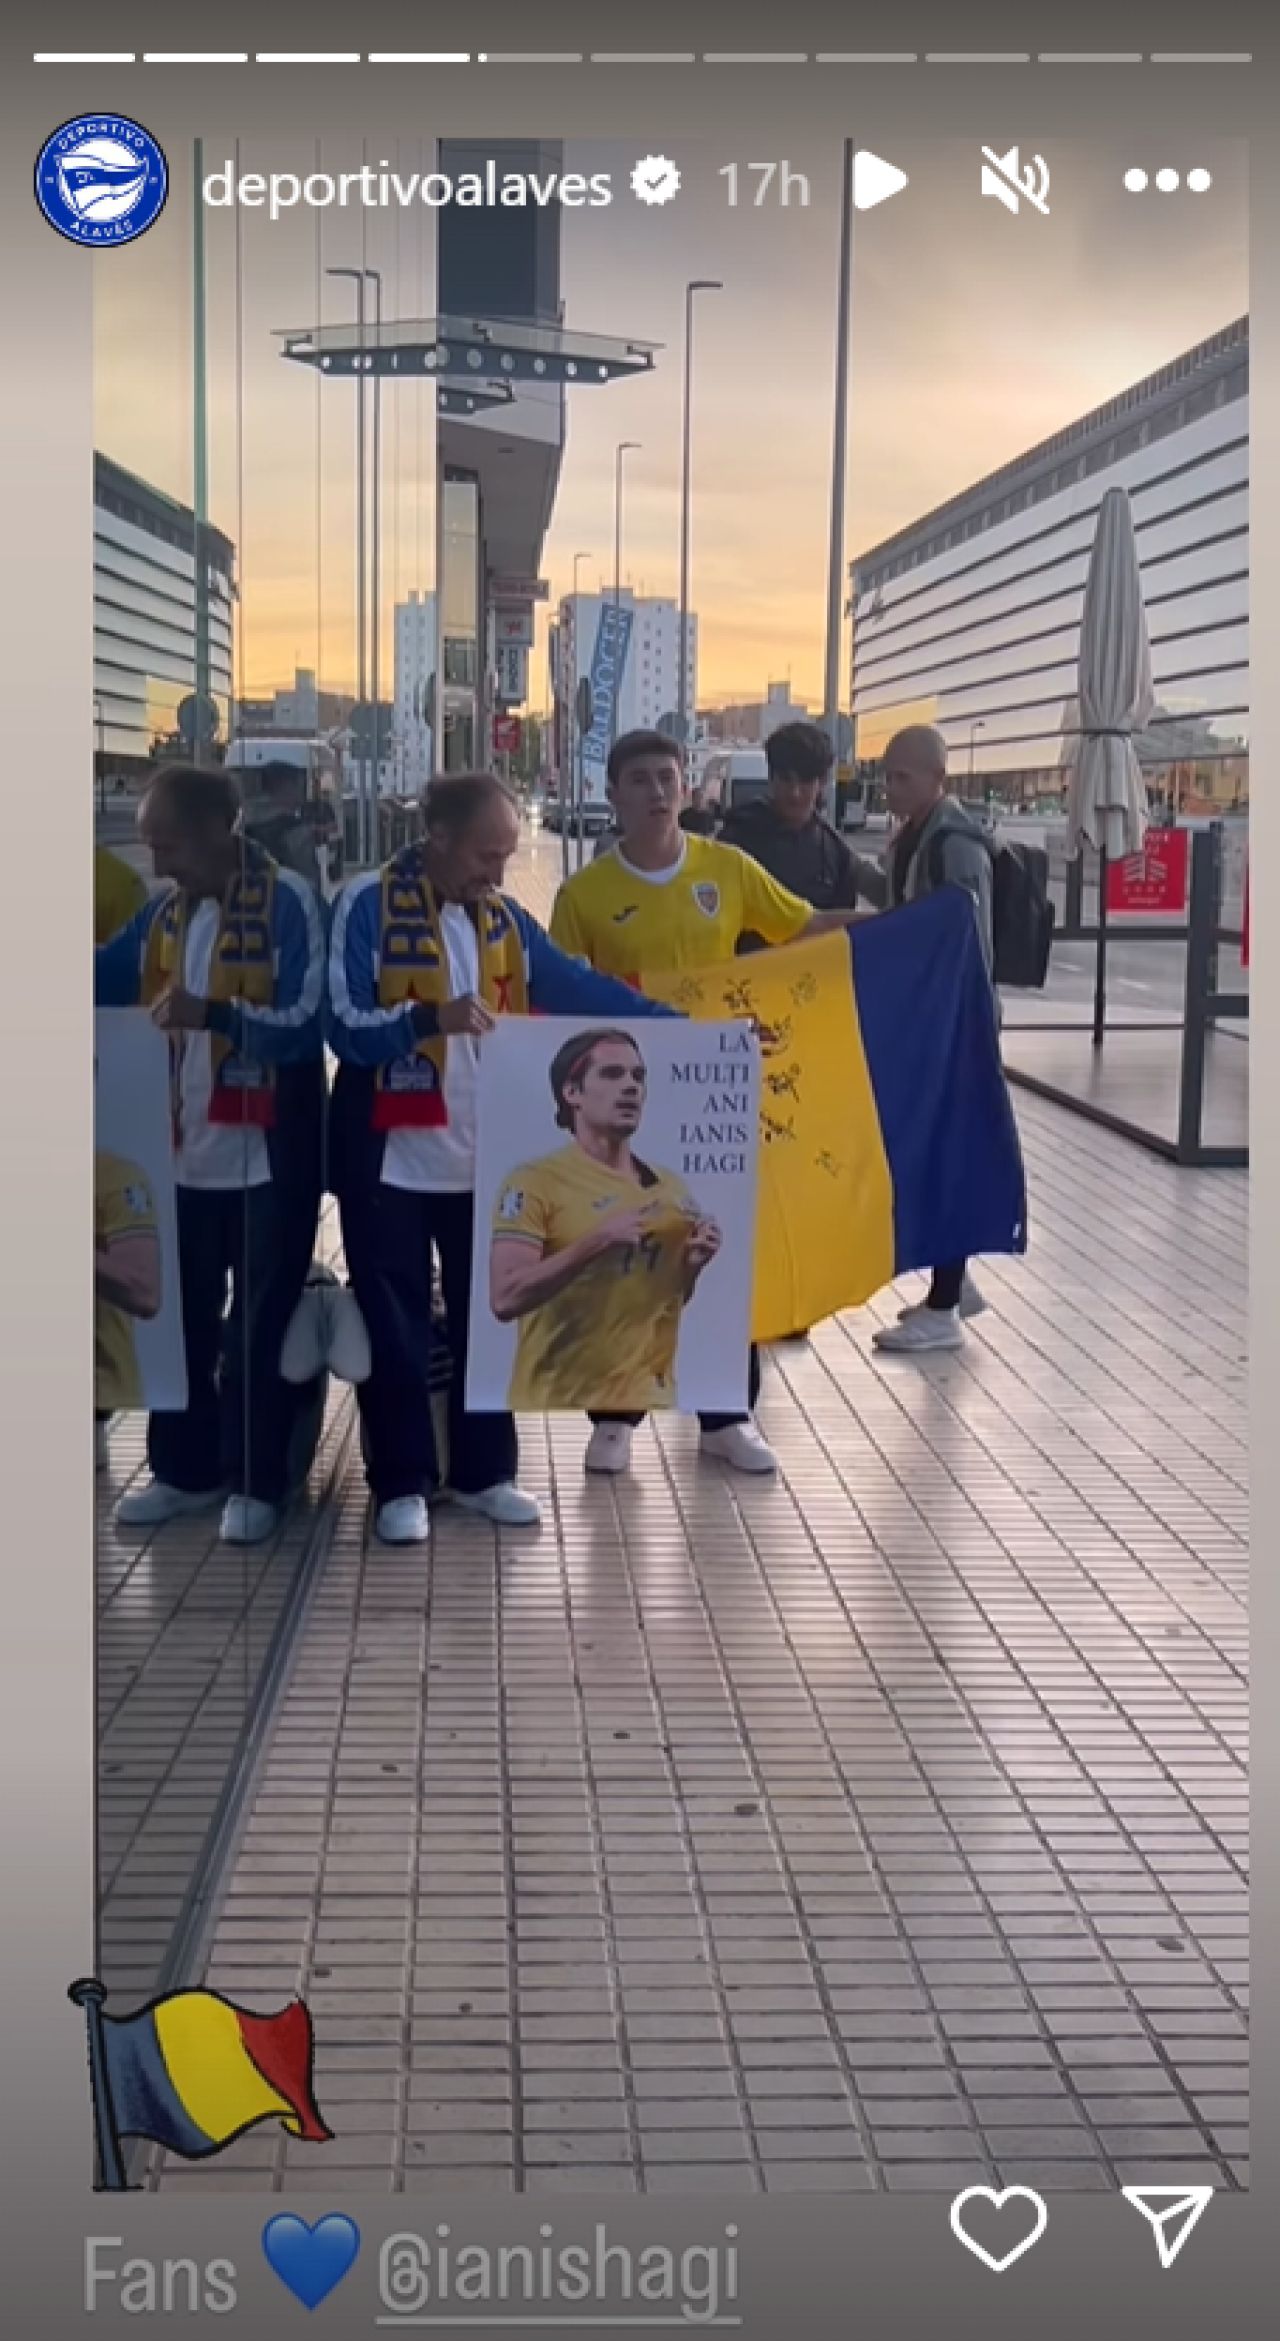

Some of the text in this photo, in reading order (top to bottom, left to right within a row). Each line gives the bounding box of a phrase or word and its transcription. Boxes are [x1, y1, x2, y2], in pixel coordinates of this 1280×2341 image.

[718, 1031, 751, 1053] LA
[703, 1093, 749, 1113] ANI
[679, 1122, 749, 1144] IANIS
[682, 1152, 747, 1174] HAGI
